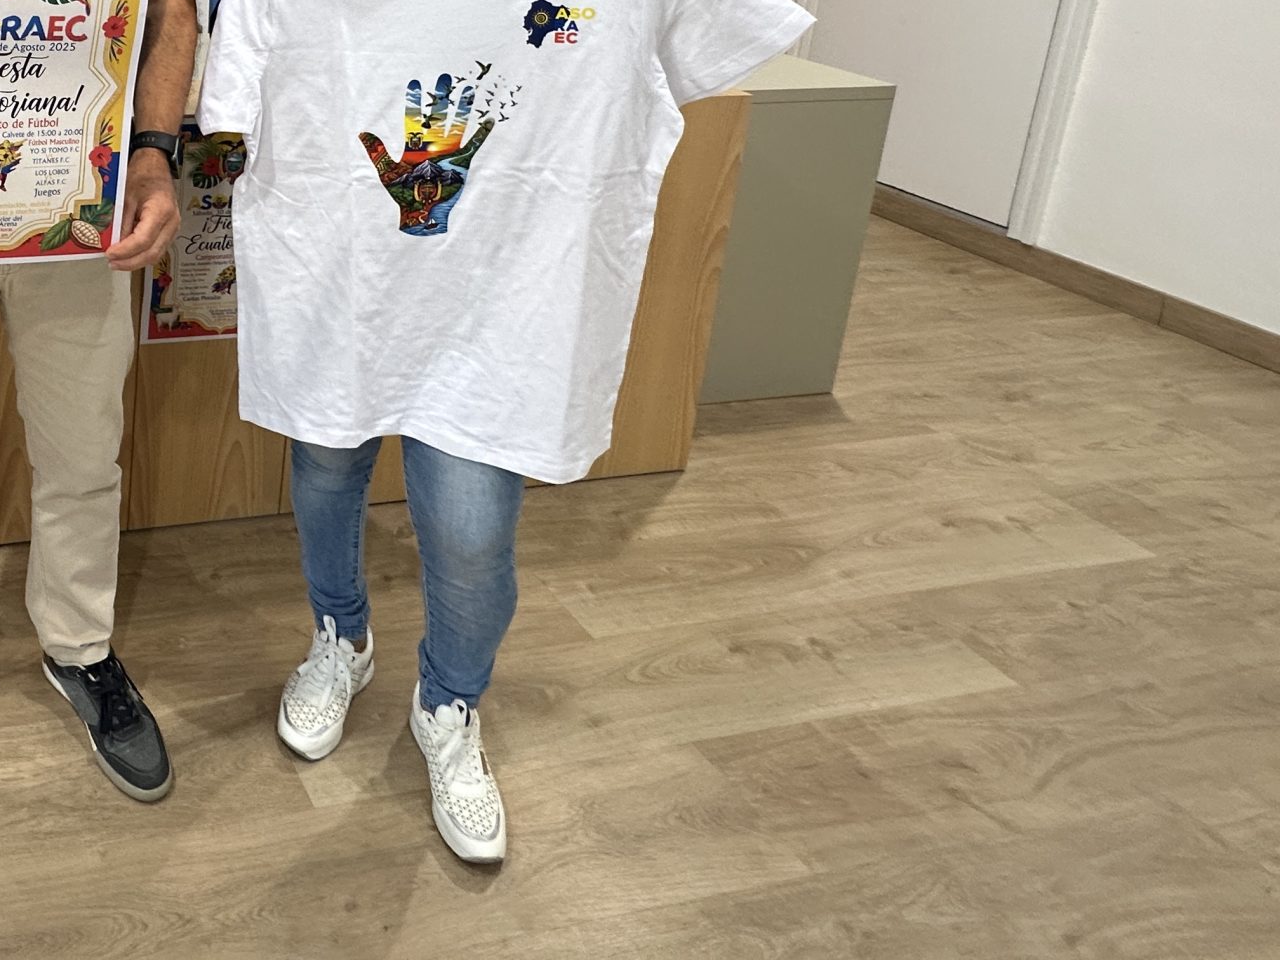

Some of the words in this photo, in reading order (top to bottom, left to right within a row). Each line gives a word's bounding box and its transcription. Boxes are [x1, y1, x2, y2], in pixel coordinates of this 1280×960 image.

[555, 7, 596, 19] ASO
[554, 33, 578, 44] EC
[11, 43, 45, 53] Agosto
[49, 43, 76, 51] 2025
[12, 119, 24, 129] de
[28, 117, 59, 128] Fútbol
[34, 188, 60, 197] Juegos
[202, 215, 233, 234] ¡Fie
[177, 235, 233, 254] Ecuato
